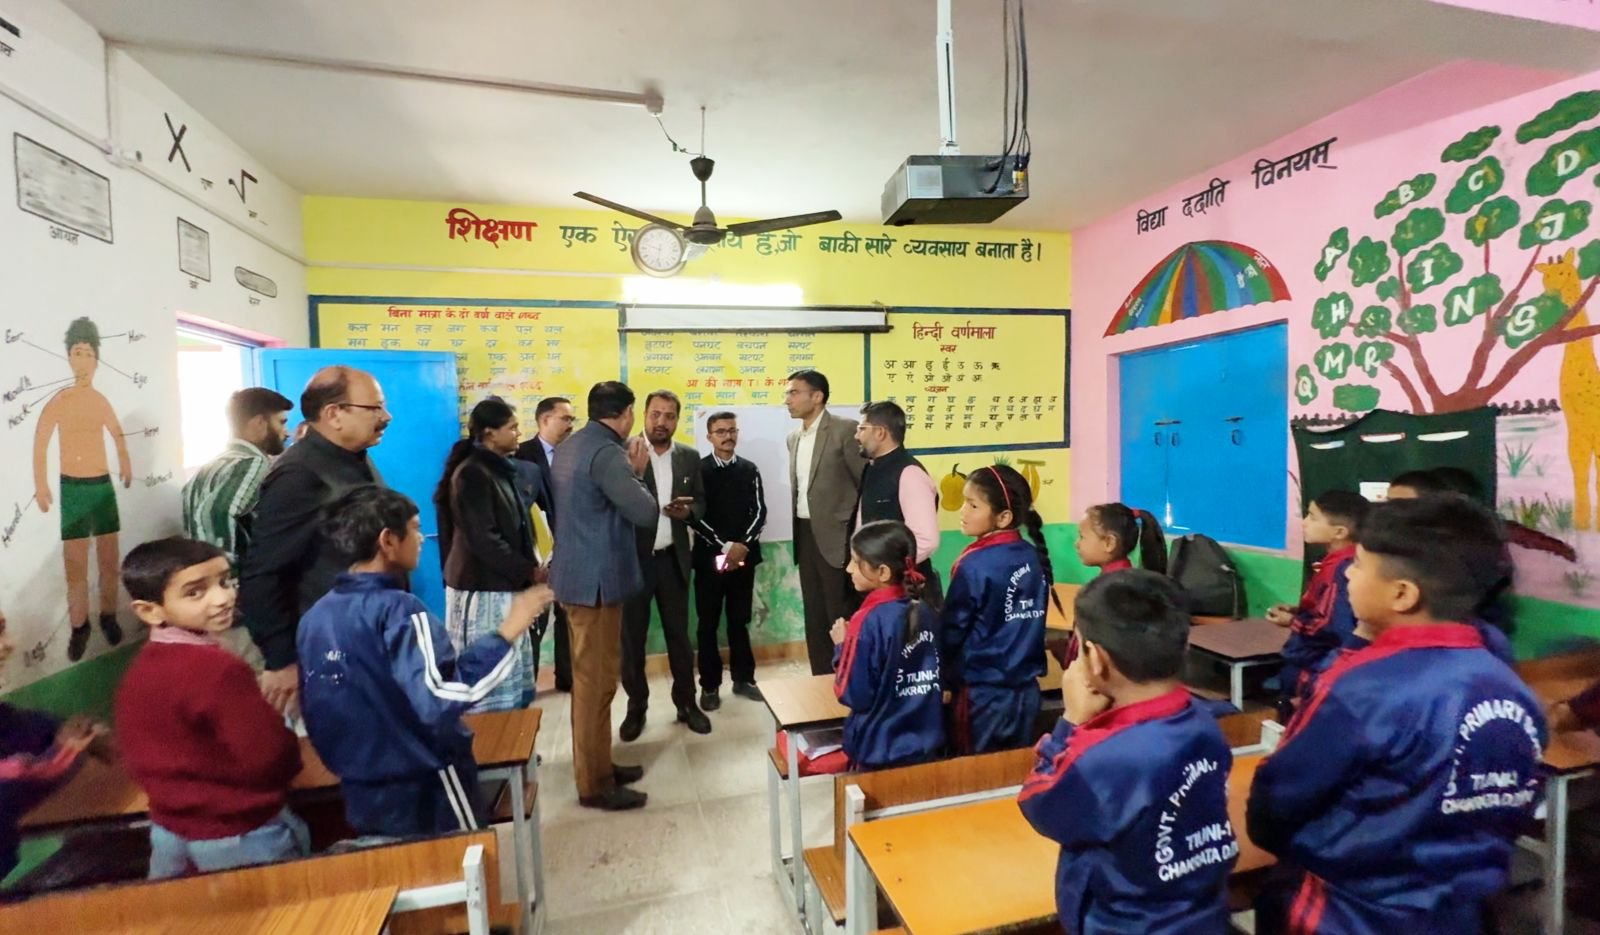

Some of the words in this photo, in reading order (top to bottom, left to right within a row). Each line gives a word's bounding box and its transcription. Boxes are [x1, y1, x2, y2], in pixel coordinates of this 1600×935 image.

[1557, 149, 1580, 176] D
[1136, 206, 1168, 235] विद्या
[1182, 177, 1231, 218] ददाति
[1251, 137, 1337, 189] विनयम्
[1468, 170, 1483, 191] C
[1399, 183, 1414, 204] B
[445, 208, 538, 249] शिक्षण
[559, 225, 598, 248] एक
[818, 231, 862, 254] बाकी
[865, 233, 897, 258] सारे
[903, 239, 970, 258] व्यवसाय
[975, 241, 1018, 260] बनाता
[1538, 213, 1566, 241] J
[1421, 258, 1435, 285] I
[1331, 299, 1346, 324] H
[1452, 287, 1475, 320] N
[912, 321, 944, 341] हिन्दी
[951, 320, 997, 340] वर्णमाला
[1507, 305, 1537, 336] S
[940, 344, 957, 353] स्वर
[1365, 346, 1382, 371] R
[884, 359, 897, 369] अ
[902, 359, 917, 369] आ
[1323, 349, 1345, 374] M
[1299, 376, 1313, 399] Q
[1155, 810, 1177, 864] GOVT.
